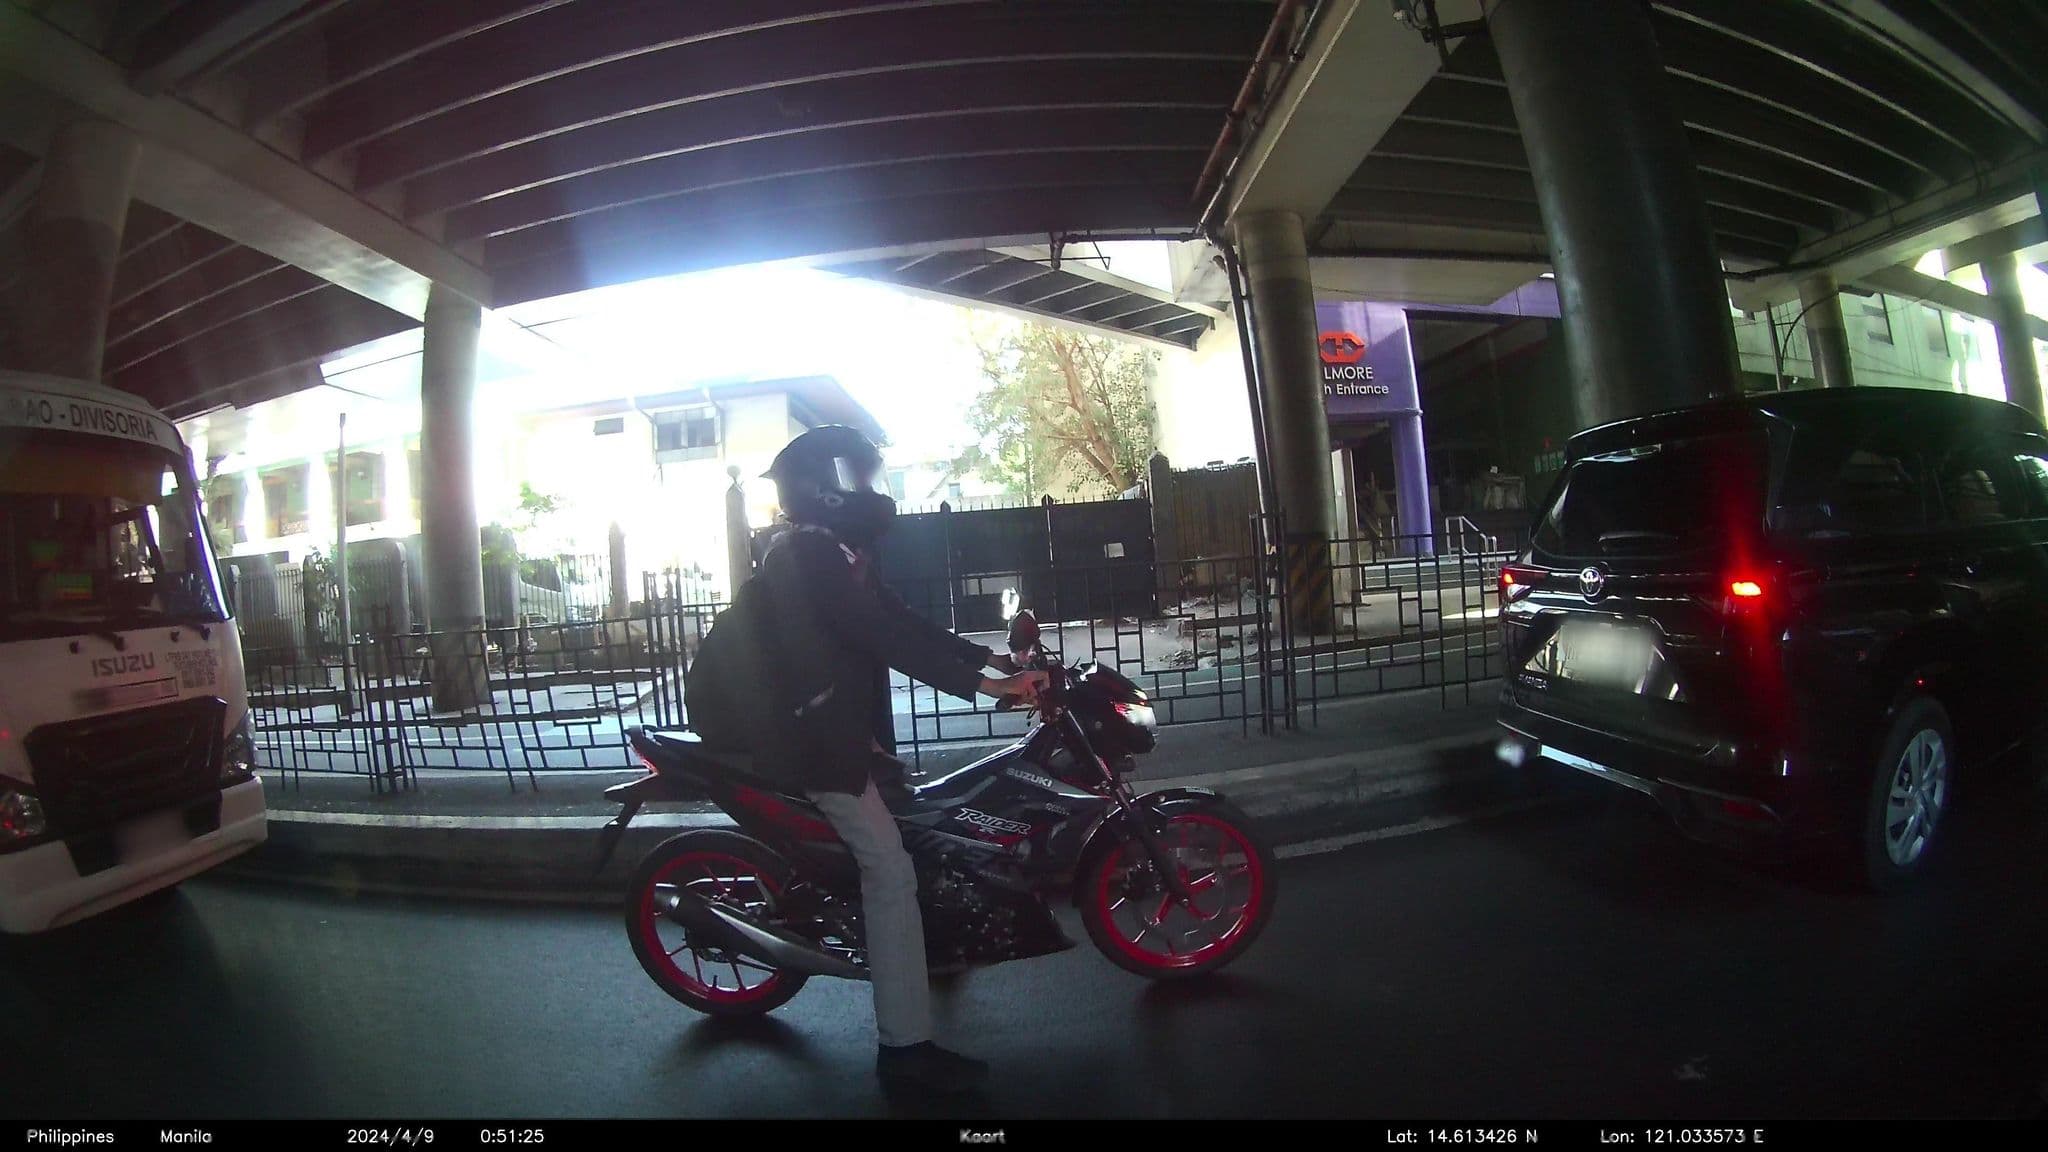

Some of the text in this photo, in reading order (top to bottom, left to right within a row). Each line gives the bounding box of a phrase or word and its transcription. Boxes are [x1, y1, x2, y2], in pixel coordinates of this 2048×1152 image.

[1323, 366, 1374, 380] LMORE
[1336, 382, 1390, 395] Entrance
[69, 403, 158, 441] DIVISORIA
[91, 652, 155, 677] ISUZU
[1006, 767, 1054, 788] SUZUKI
[954, 807, 1032, 835] RAIDER
